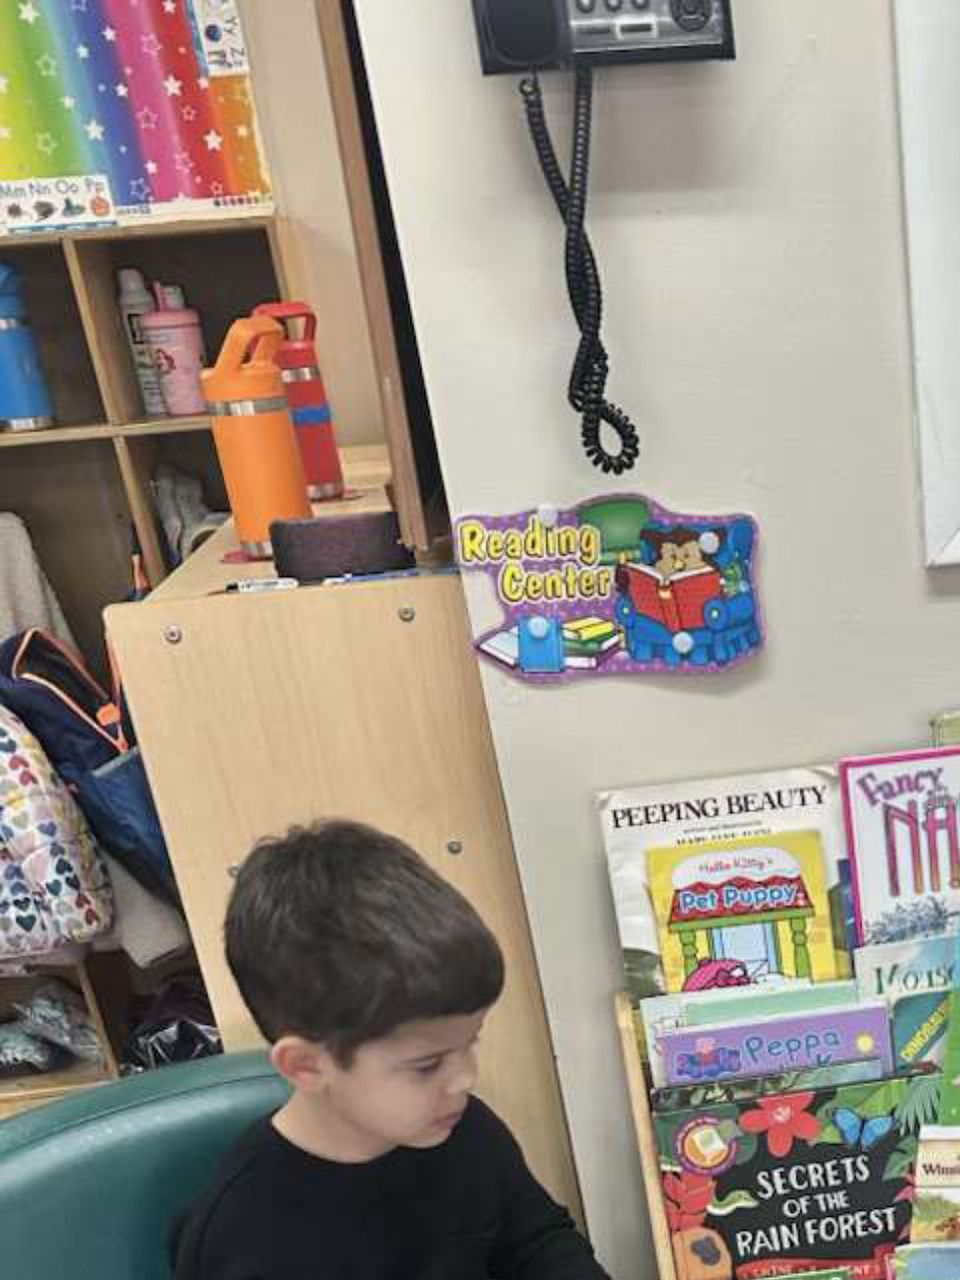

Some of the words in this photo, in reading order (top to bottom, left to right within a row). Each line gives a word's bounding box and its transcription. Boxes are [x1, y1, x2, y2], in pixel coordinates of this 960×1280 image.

[55, 179, 79, 194] Oo
[459, 516, 599, 564] Reading
[502, 566, 610, 601] Center
[857, 767, 943, 807] Fancy
[611, 797, 720, 829] PEEPING
[727, 784, 828, 816] BEAUTY
[680, 889, 716, 911] Pet
[724, 883, 798, 910] Puppy
[745, 1031, 840, 1064] Peppa
[756, 1154, 870, 1201] SECRETS
[782, 1196, 812, 1218] OF
[815, 1190, 849, 1212] THE
[735, 1223, 800, 1257] RAIN
[805, 1206, 898, 1246] FOREST
